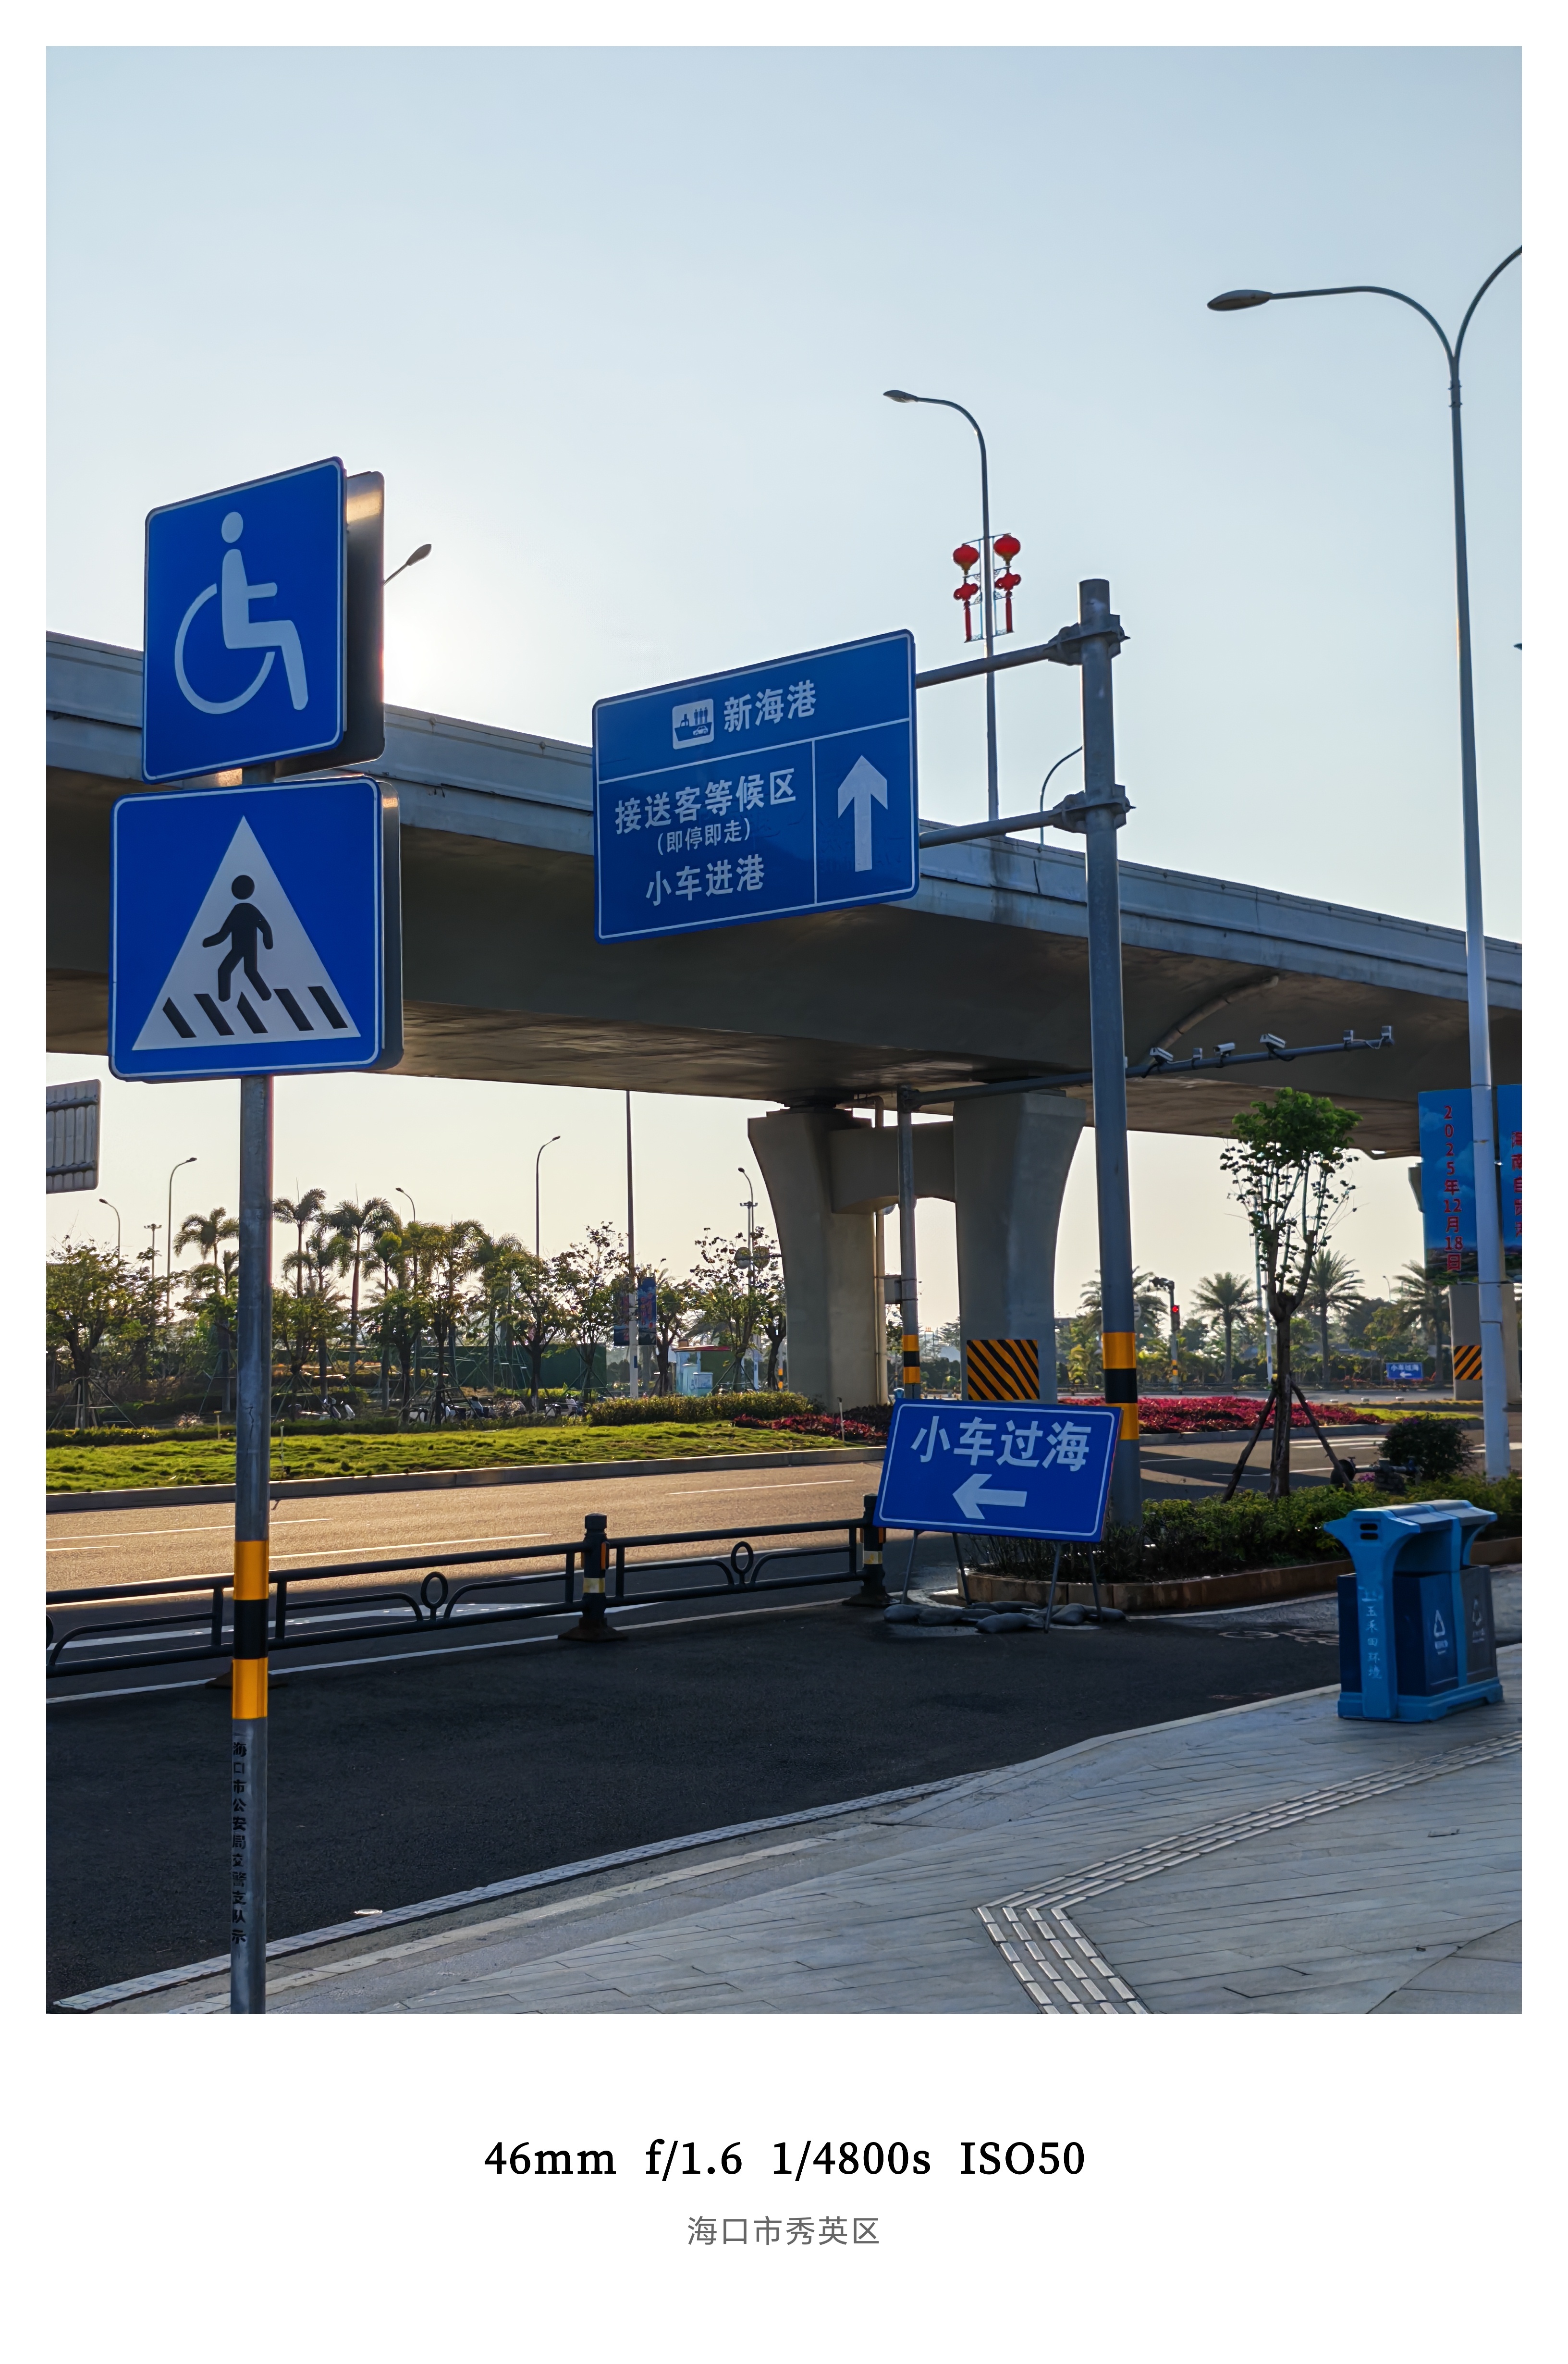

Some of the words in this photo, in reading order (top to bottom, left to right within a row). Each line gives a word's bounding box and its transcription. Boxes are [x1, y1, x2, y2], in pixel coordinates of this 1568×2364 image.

[723, 679, 816, 733] 新海港
[614, 768, 796, 835] 接送客等候区
[657, 818, 750, 856] (即停即走)
[646, 854, 765, 907] 小车进港
[1444, 1105, 1463, 1271] 2025年12月18日
[910, 1416, 1092, 1472] 小车过海
